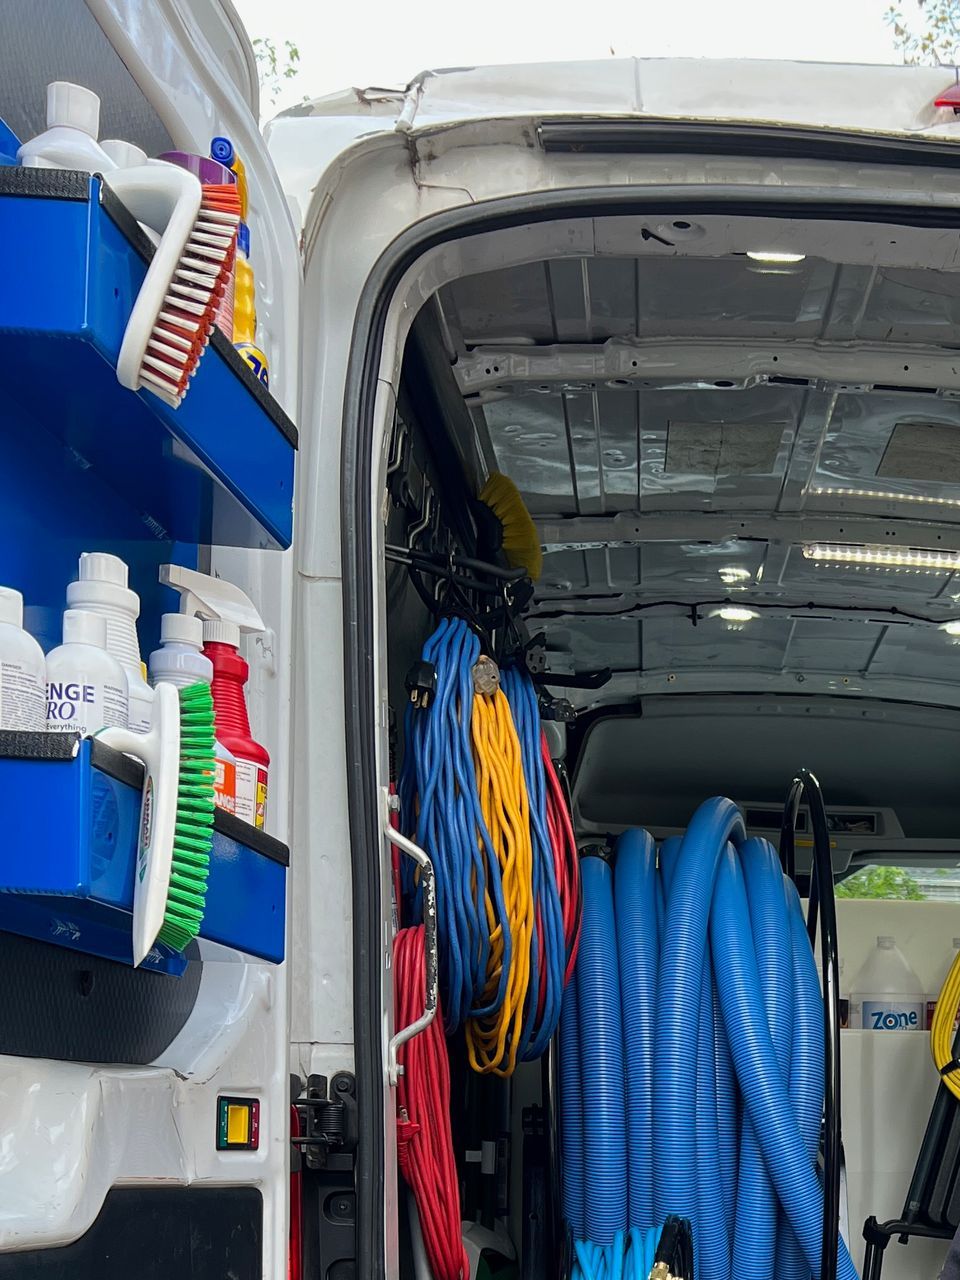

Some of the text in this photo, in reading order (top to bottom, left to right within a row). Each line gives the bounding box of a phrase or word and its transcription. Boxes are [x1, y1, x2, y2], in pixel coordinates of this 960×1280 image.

[46, 682, 95, 704] NGE
[46, 722, 87, 734] Everything
[871, 1011, 917, 1030] Zone
